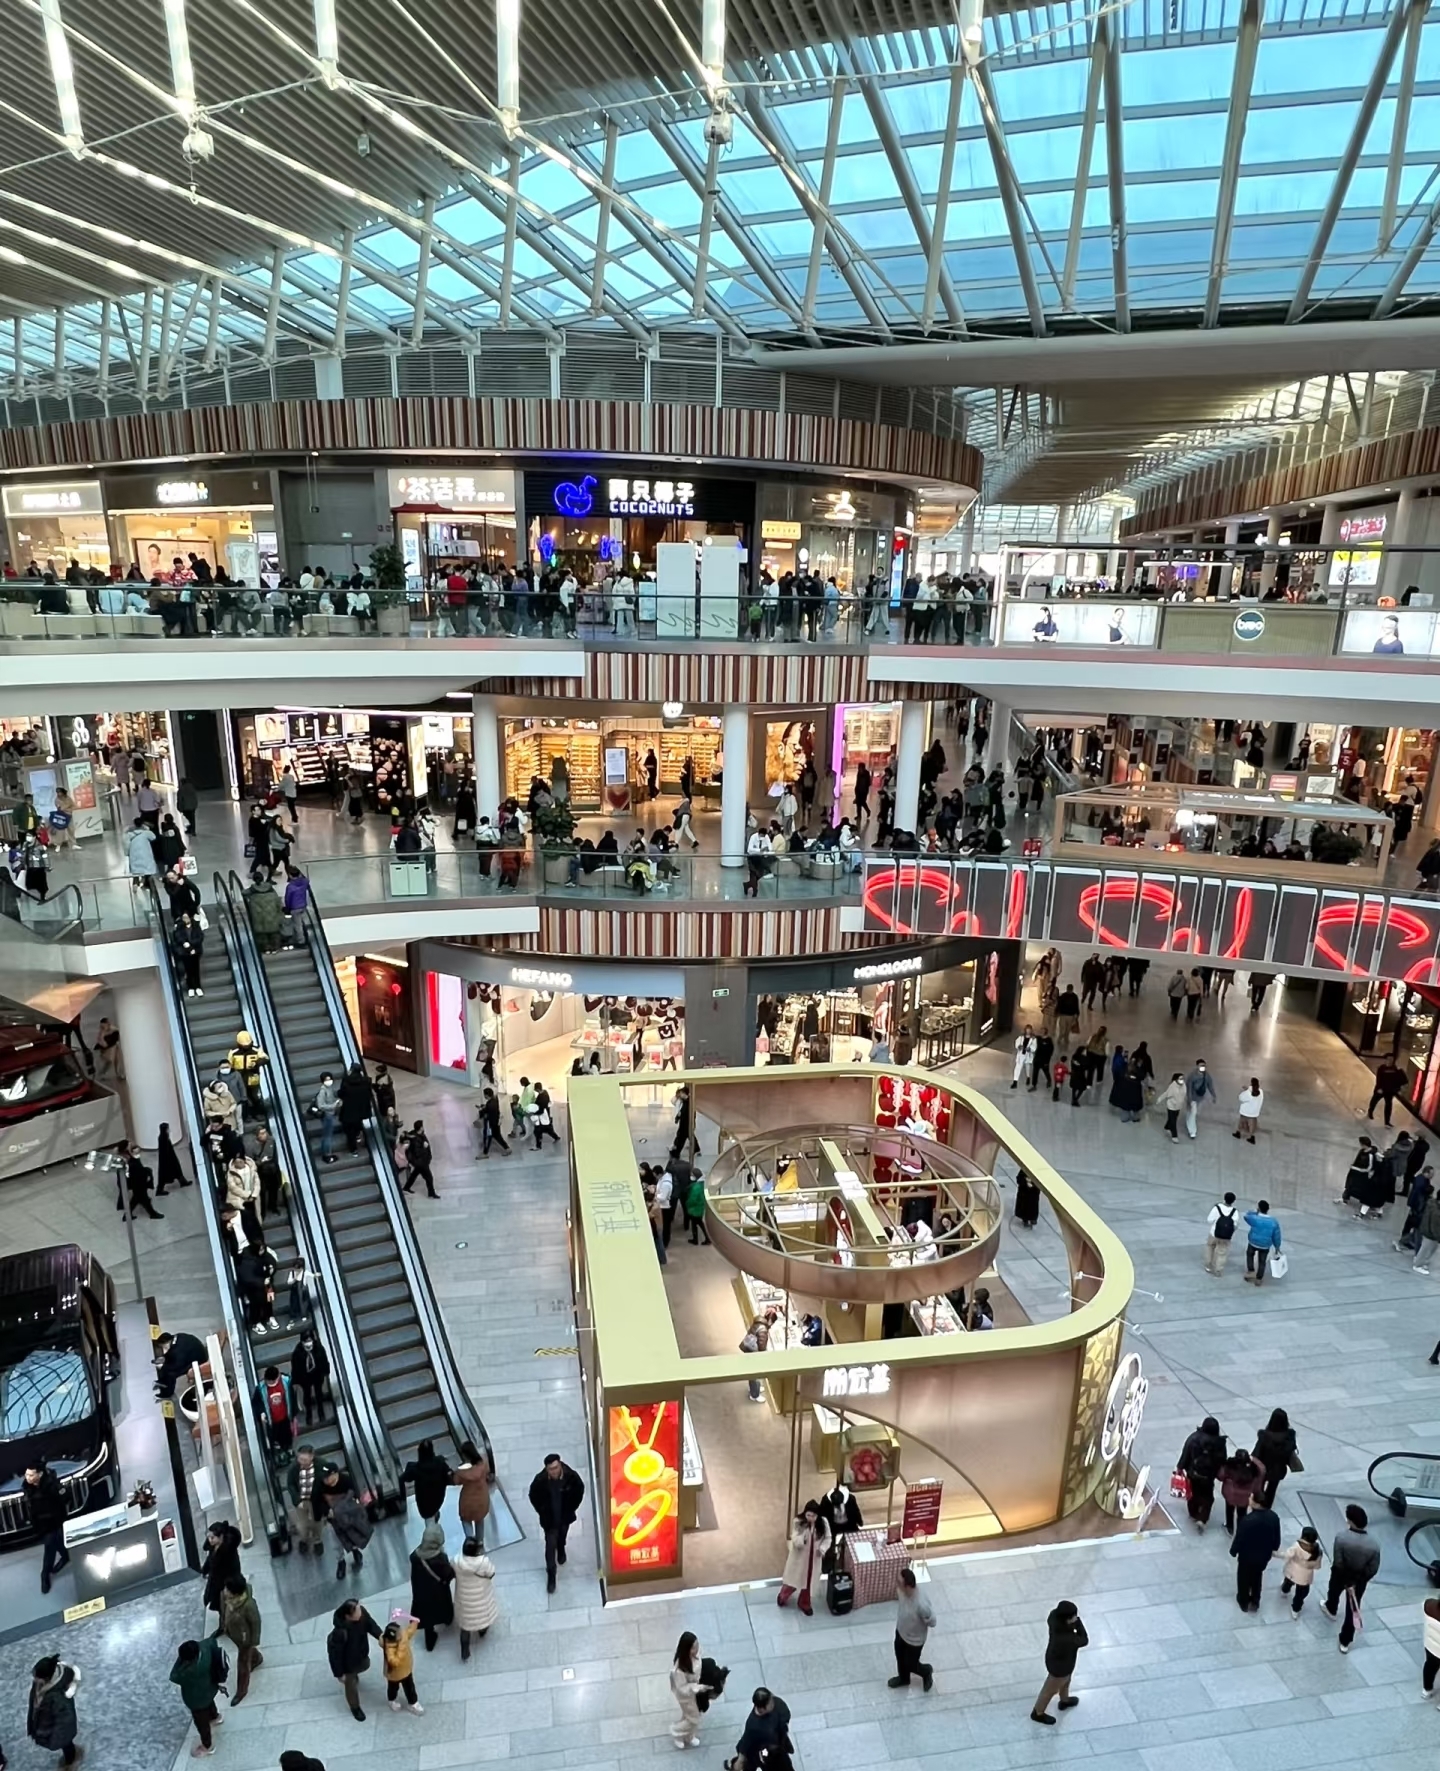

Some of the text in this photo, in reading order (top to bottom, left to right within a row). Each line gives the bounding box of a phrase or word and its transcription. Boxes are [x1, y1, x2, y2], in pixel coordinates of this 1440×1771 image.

[406, 477, 477, 502] 茶话弄
[853, 956, 923, 979] MONOLOGUE
